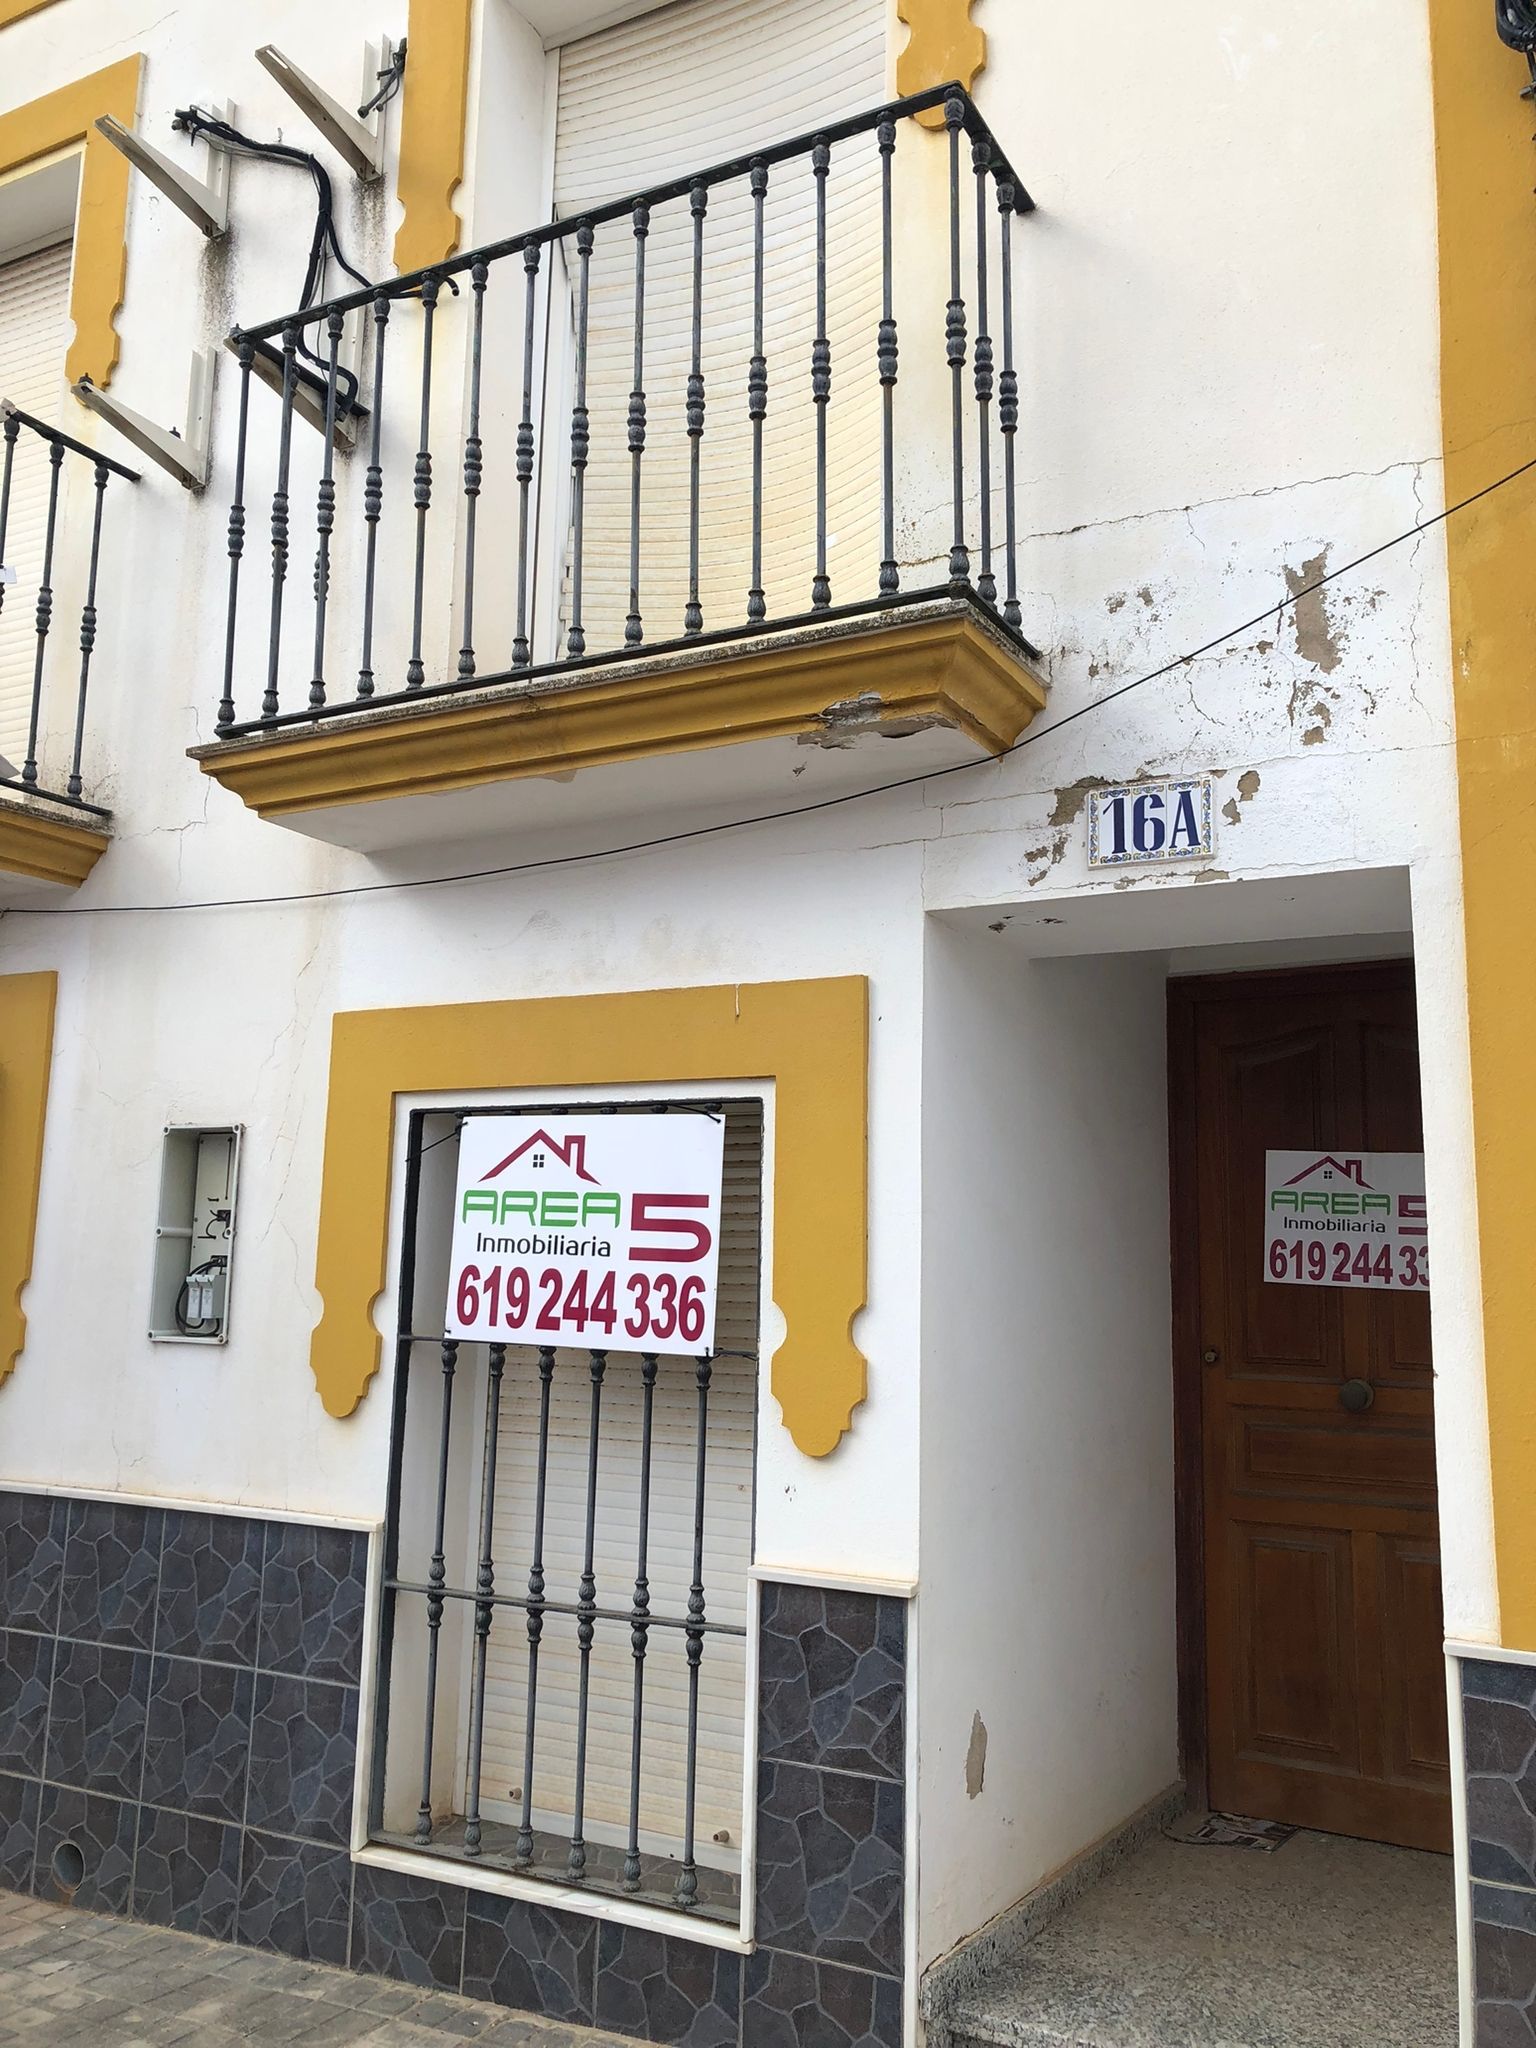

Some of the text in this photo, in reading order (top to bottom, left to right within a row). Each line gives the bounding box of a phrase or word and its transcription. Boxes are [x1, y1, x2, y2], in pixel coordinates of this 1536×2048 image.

[1102, 789, 1202, 855] 16A
[462, 1189, 712, 1263] AREA 5
[1270, 1189, 1392, 1216] AREA
[1283, 1216, 1386, 1233] Inmobiliaria
[476, 1232, 612, 1258] Inmobiliaria
[1269, 1238, 1327, 1281] 619
[1331, 1242, 1394, 1285] 244
[456, 1264, 706, 1342] 619 244 336
